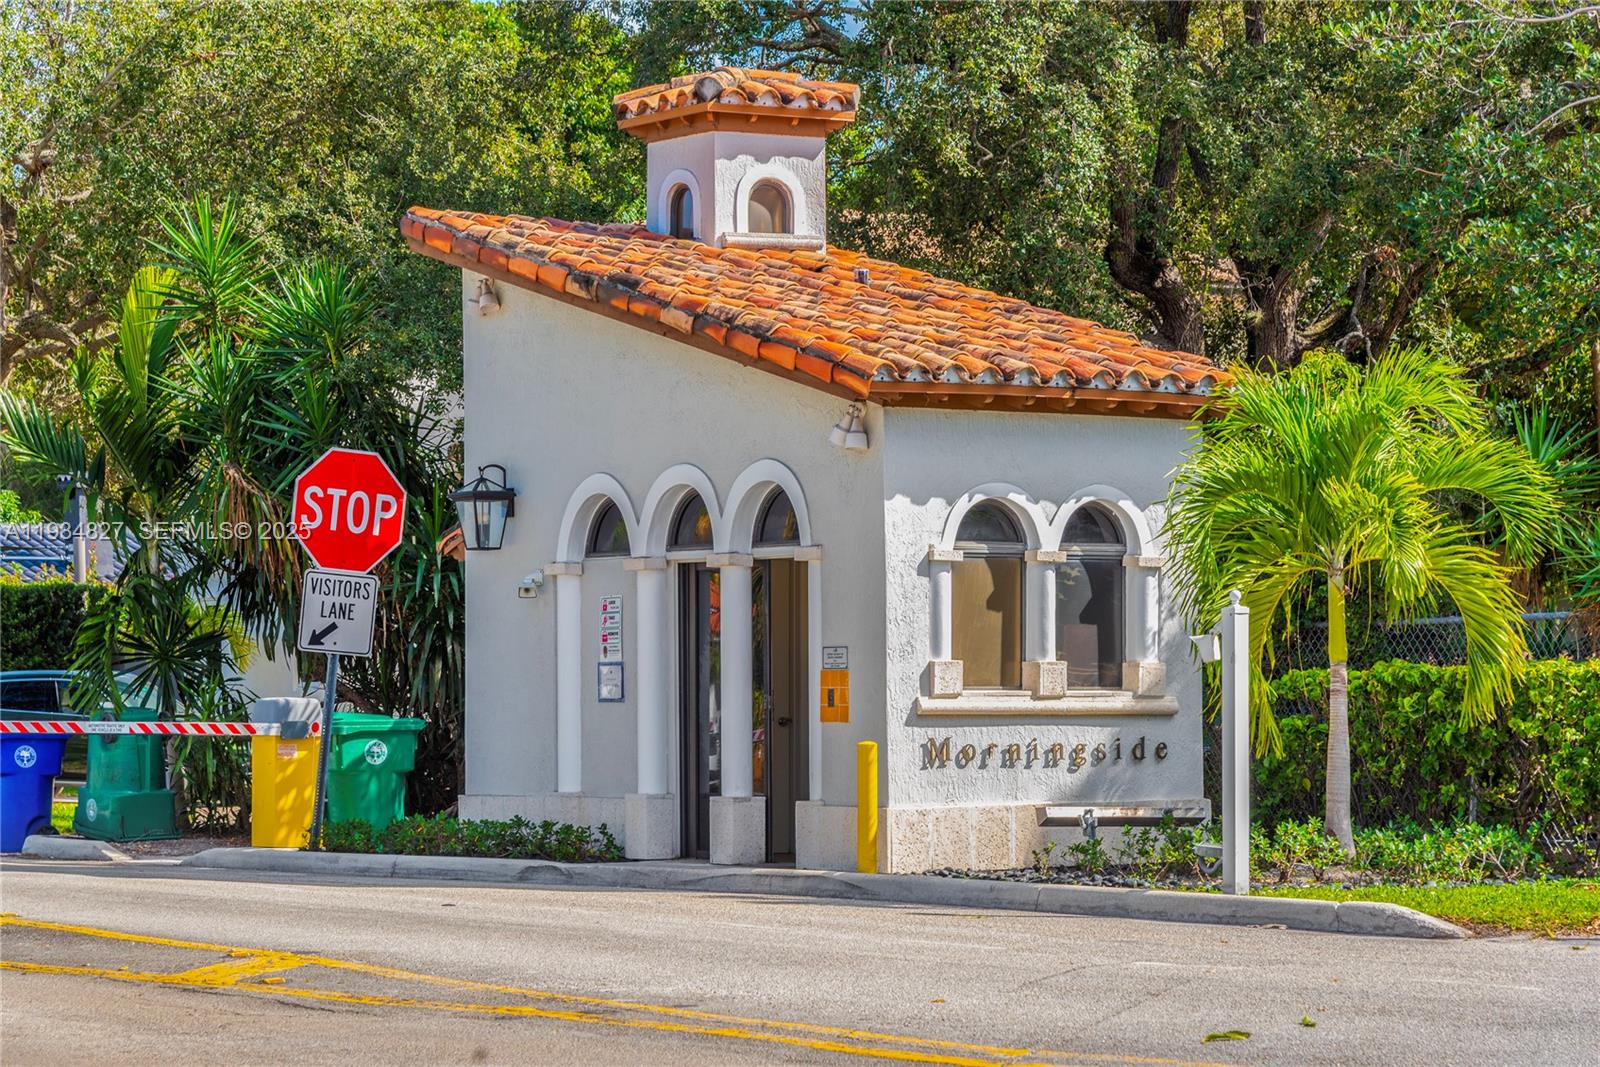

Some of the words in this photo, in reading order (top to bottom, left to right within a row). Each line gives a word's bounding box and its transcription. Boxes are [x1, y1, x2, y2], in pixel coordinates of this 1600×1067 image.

[300, 485, 398, 536] STOP
[310, 577, 372, 600] VISITORS
[319, 601, 356, 621] LANE
[922, 735, 1168, 769] Morningside
